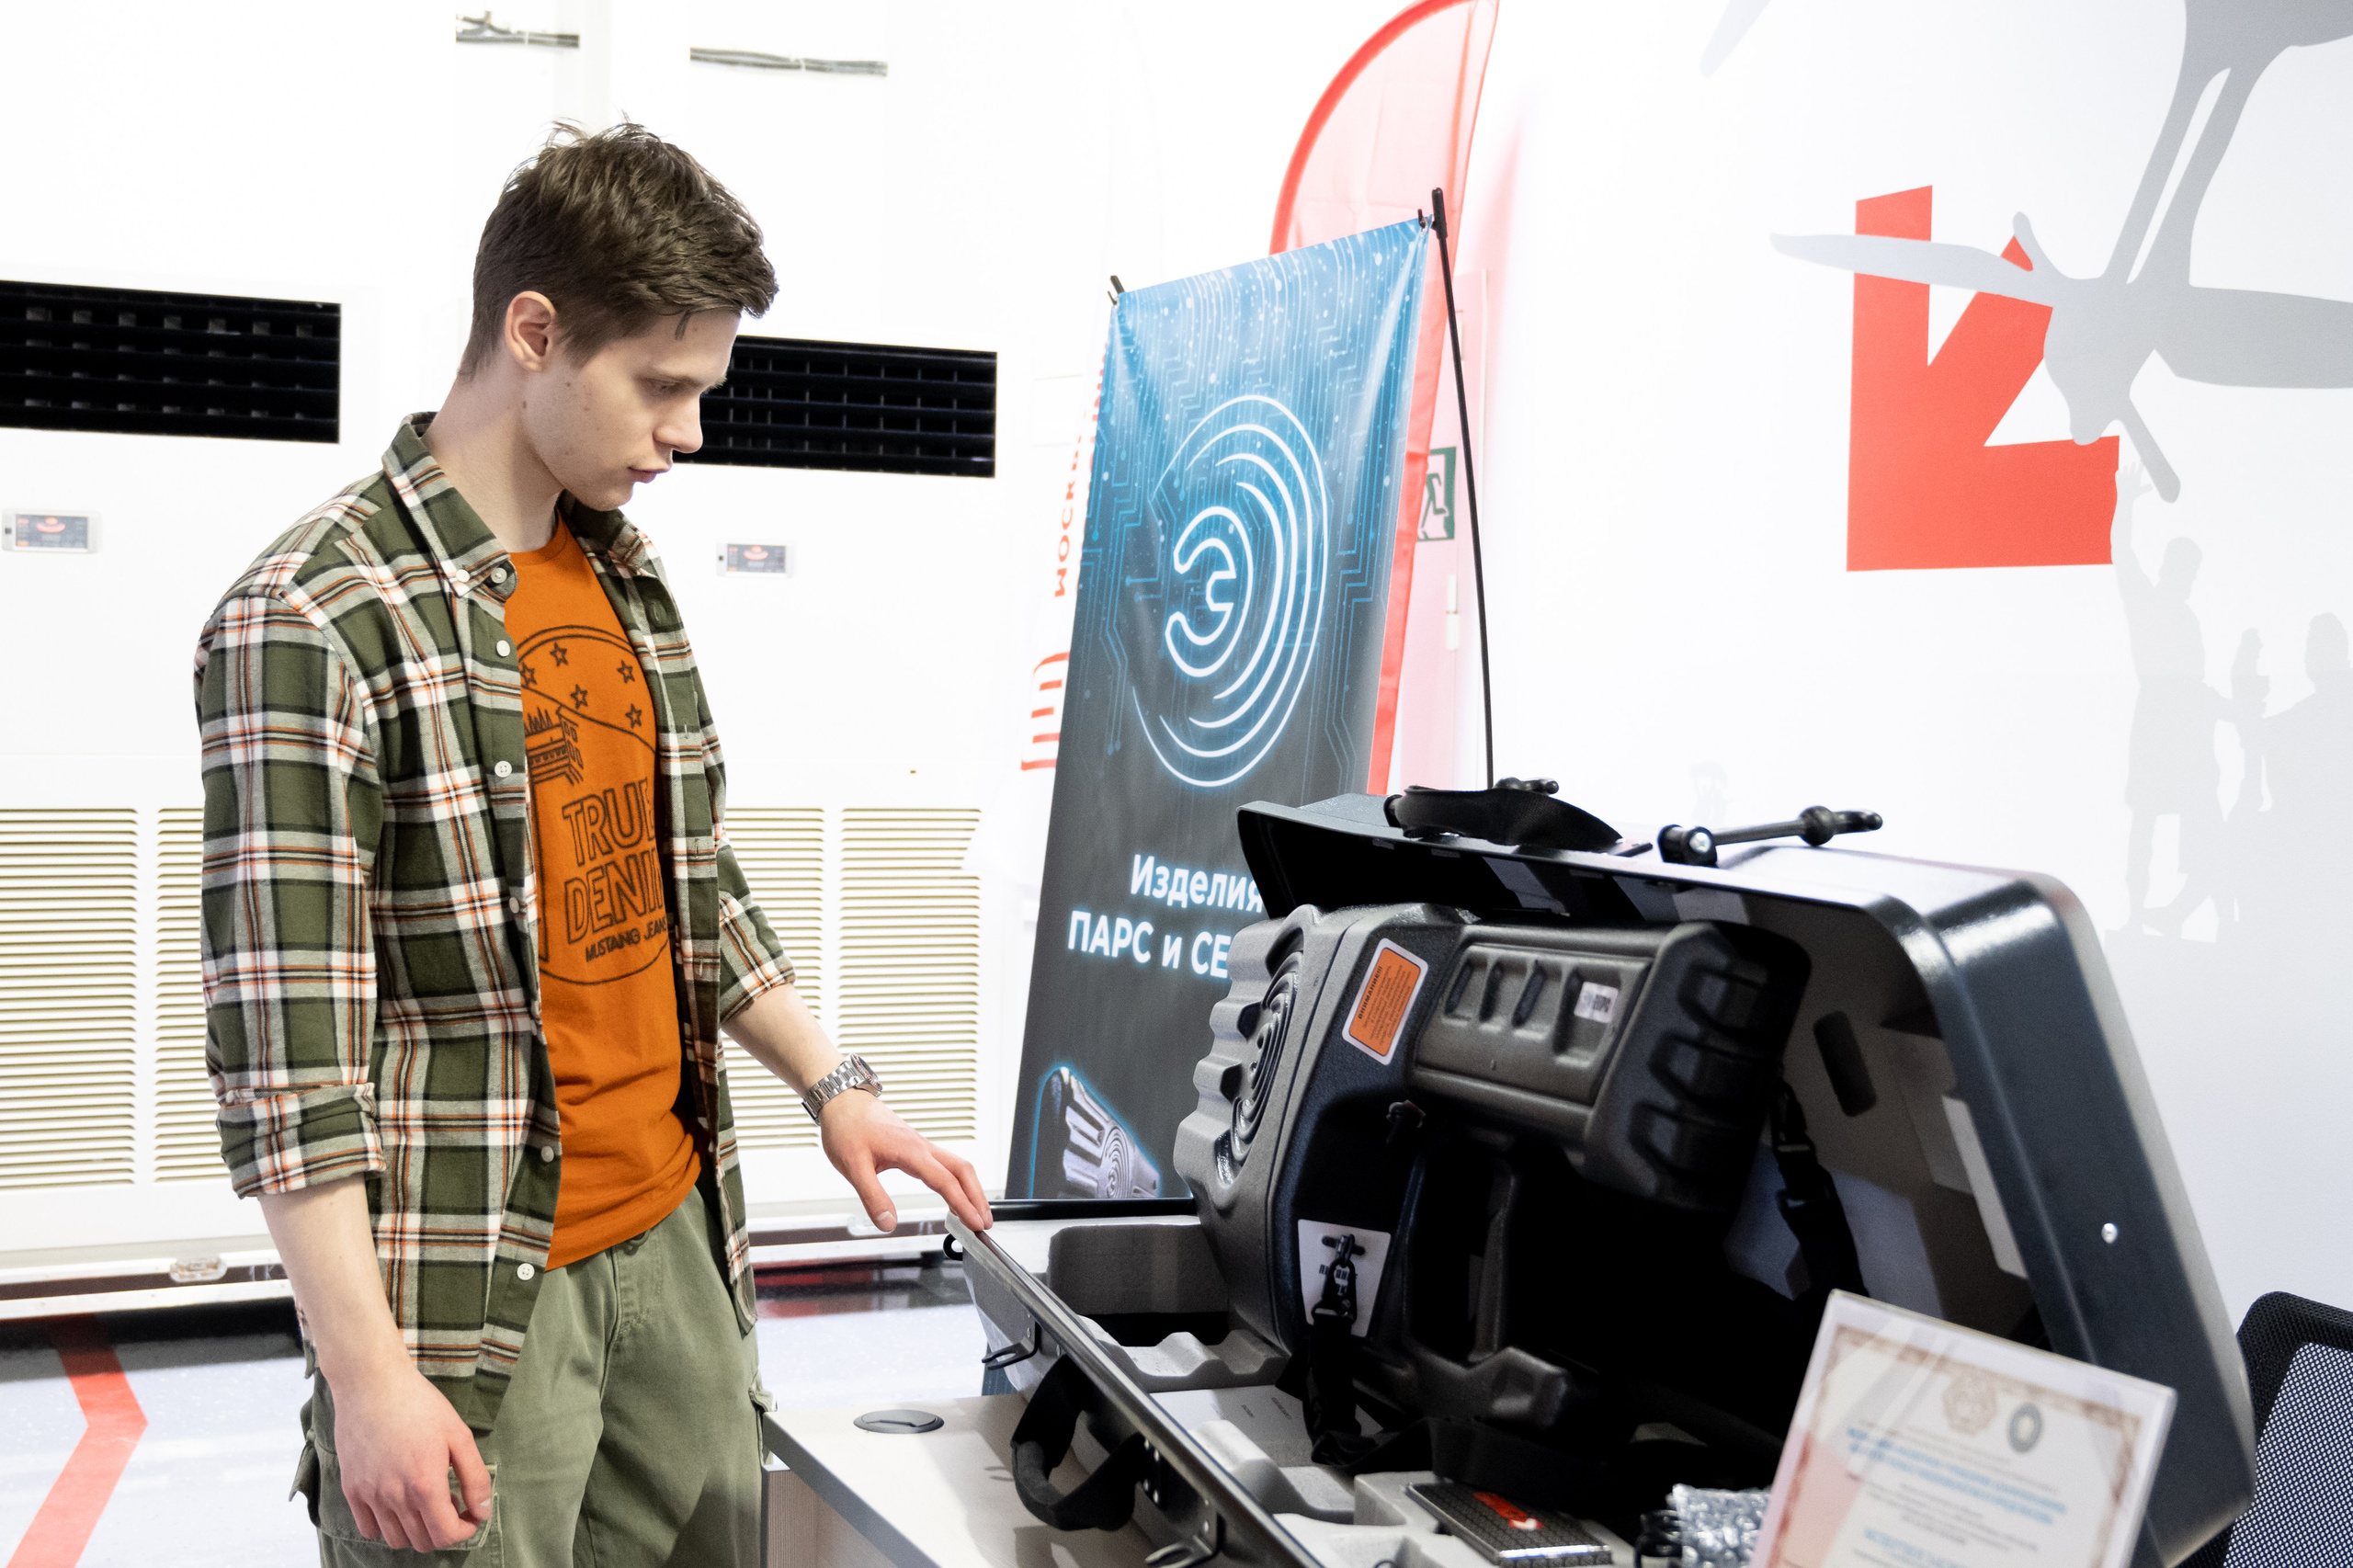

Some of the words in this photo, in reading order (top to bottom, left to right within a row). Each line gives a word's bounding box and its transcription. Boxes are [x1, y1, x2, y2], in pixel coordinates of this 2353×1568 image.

[1130, 853, 1264, 914] Изделия
[585, 927, 641, 962] MUSTANG
[1067, 910, 1154, 963] ПАРС
[1161, 934, 1183, 969] и
